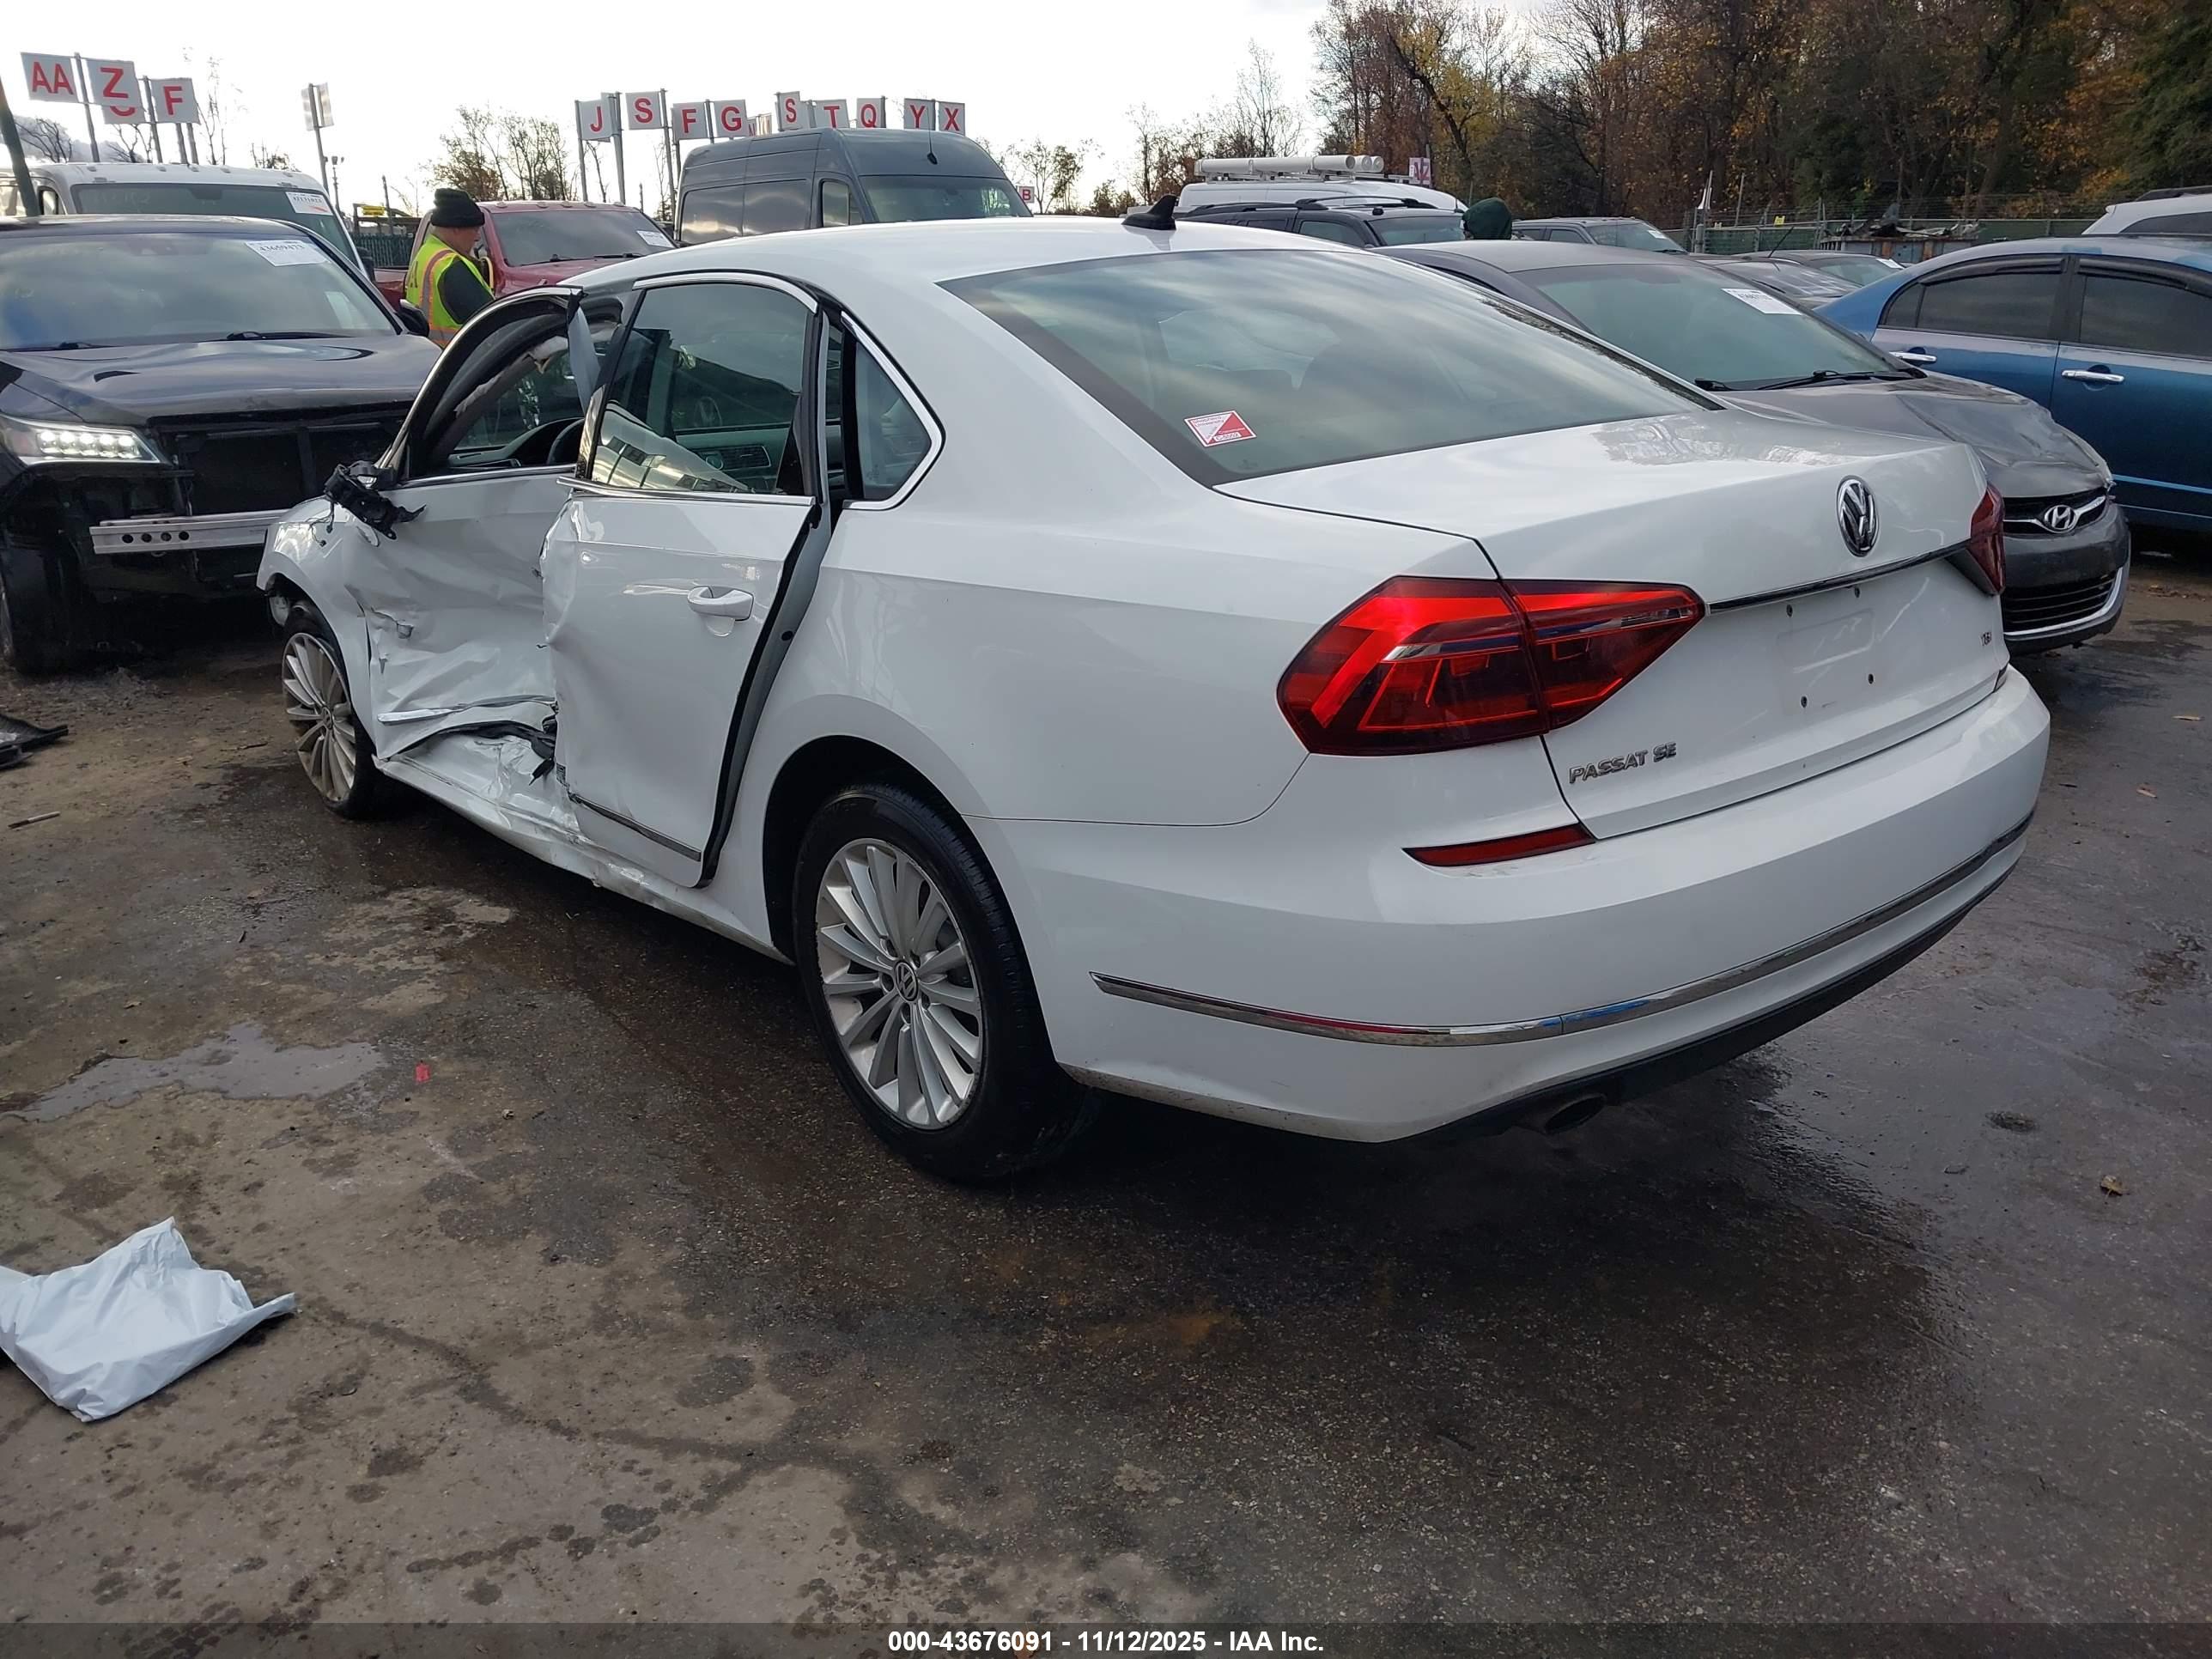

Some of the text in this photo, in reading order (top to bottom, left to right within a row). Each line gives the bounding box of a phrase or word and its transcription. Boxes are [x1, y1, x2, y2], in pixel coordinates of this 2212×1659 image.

[32, 61, 74, 94] AA
[100, 67, 129, 99] Z
[163, 86, 183, 115] F
[635, 97, 653, 124] S
[786, 98, 797, 124] S
[590, 106, 602, 132] J
[683, 109, 696, 134] F
[721, 106, 742, 131] G
[823, 105, 841, 128] T
[861, 103, 877, 129] Q
[911, 105, 927, 129] Y
[945, 107, 960, 132] X
[1569, 742, 1677, 784] PASSAT SE
